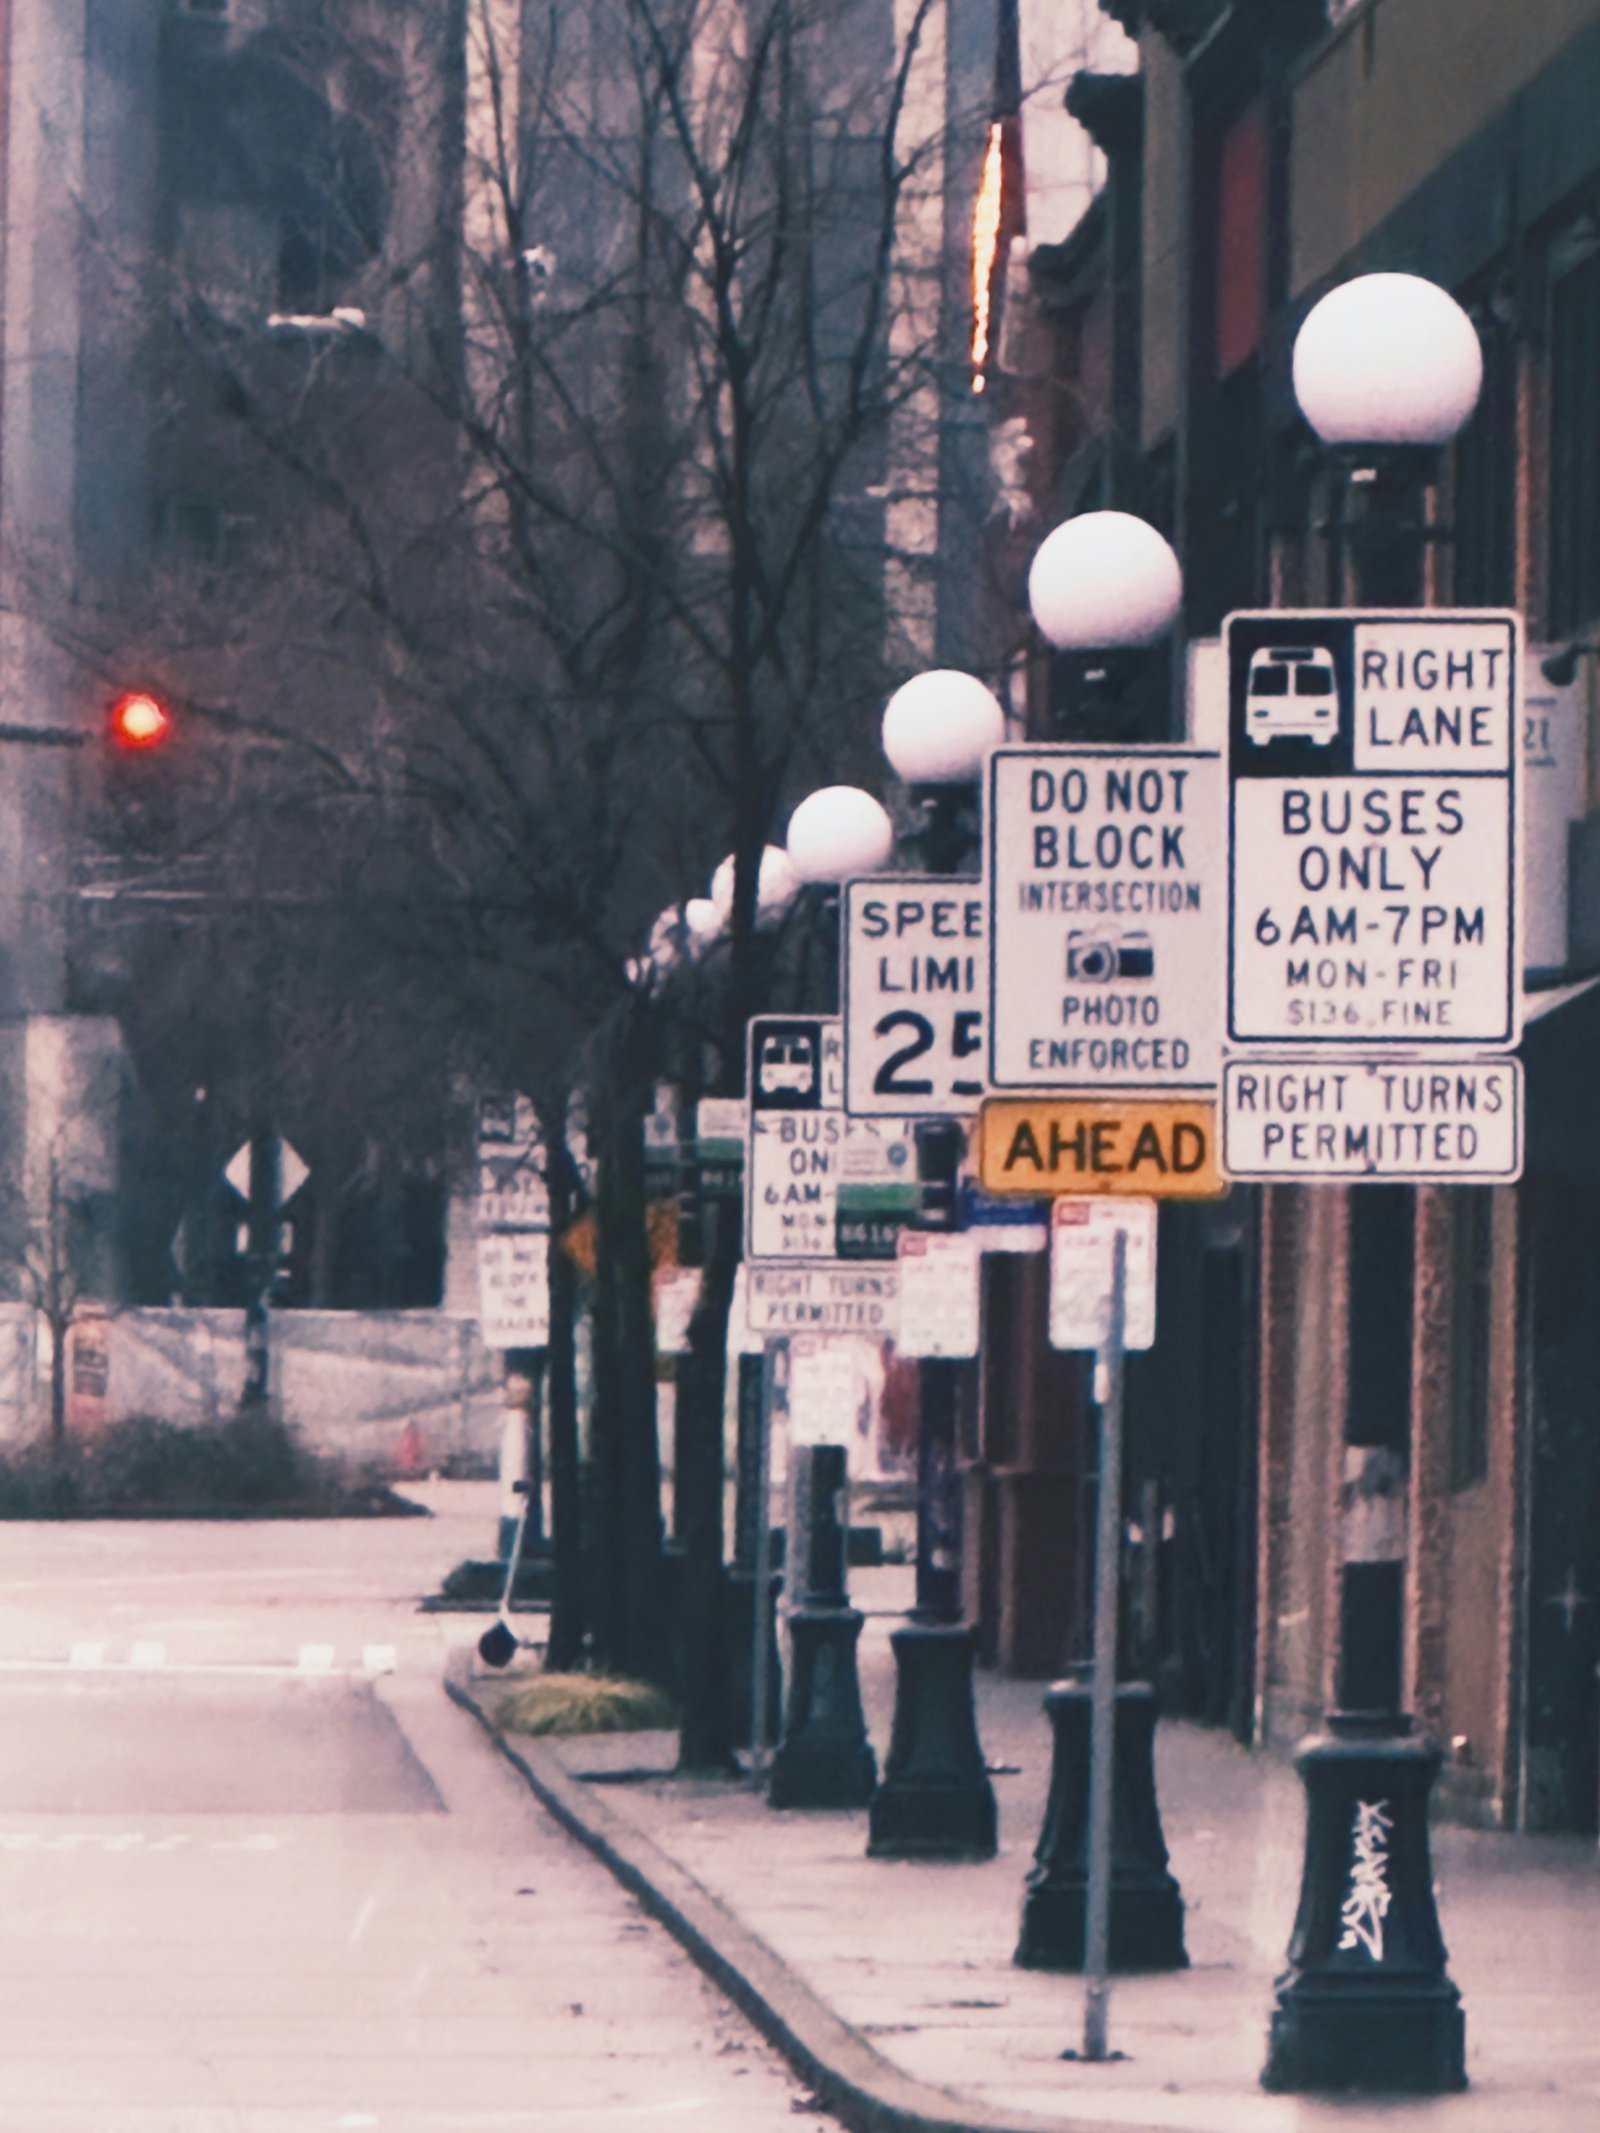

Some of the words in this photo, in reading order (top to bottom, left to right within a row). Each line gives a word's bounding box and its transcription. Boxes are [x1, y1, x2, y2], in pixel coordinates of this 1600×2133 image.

[1361, 648, 1505, 692] RIGHT
[1369, 706, 1494, 747] LANE
[1029, 768, 1089, 814] DO
[1105, 768, 1189, 814] NOT
[1282, 789, 1465, 836] BUSES
[1033, 824, 1186, 870] BLOCK
[1298, 845, 1443, 893] ONLY
[1018, 880, 1202, 914] INTERSECTION
[861, 900, 983, 939] SPEE
[1255, 905, 1486, 947] 6AM-7PM
[879, 956, 976, 995] LIMI
[1286, 958, 1458, 989] MON-FRI
[1061, 994, 1160, 1027] PHOTO
[1382, 1000, 1454, 1027] FINE
[1028, 1037, 1190, 1071] ENFORCED
[1236, 1074, 1348, 1115] RIGHT
[1380, 1074, 1504, 1115] TURNS
[789, 1148, 831, 1177] ON
[1002, 1119, 1207, 1175] AHEAD
[1262, 1122, 1479, 1163] PERMITTED
